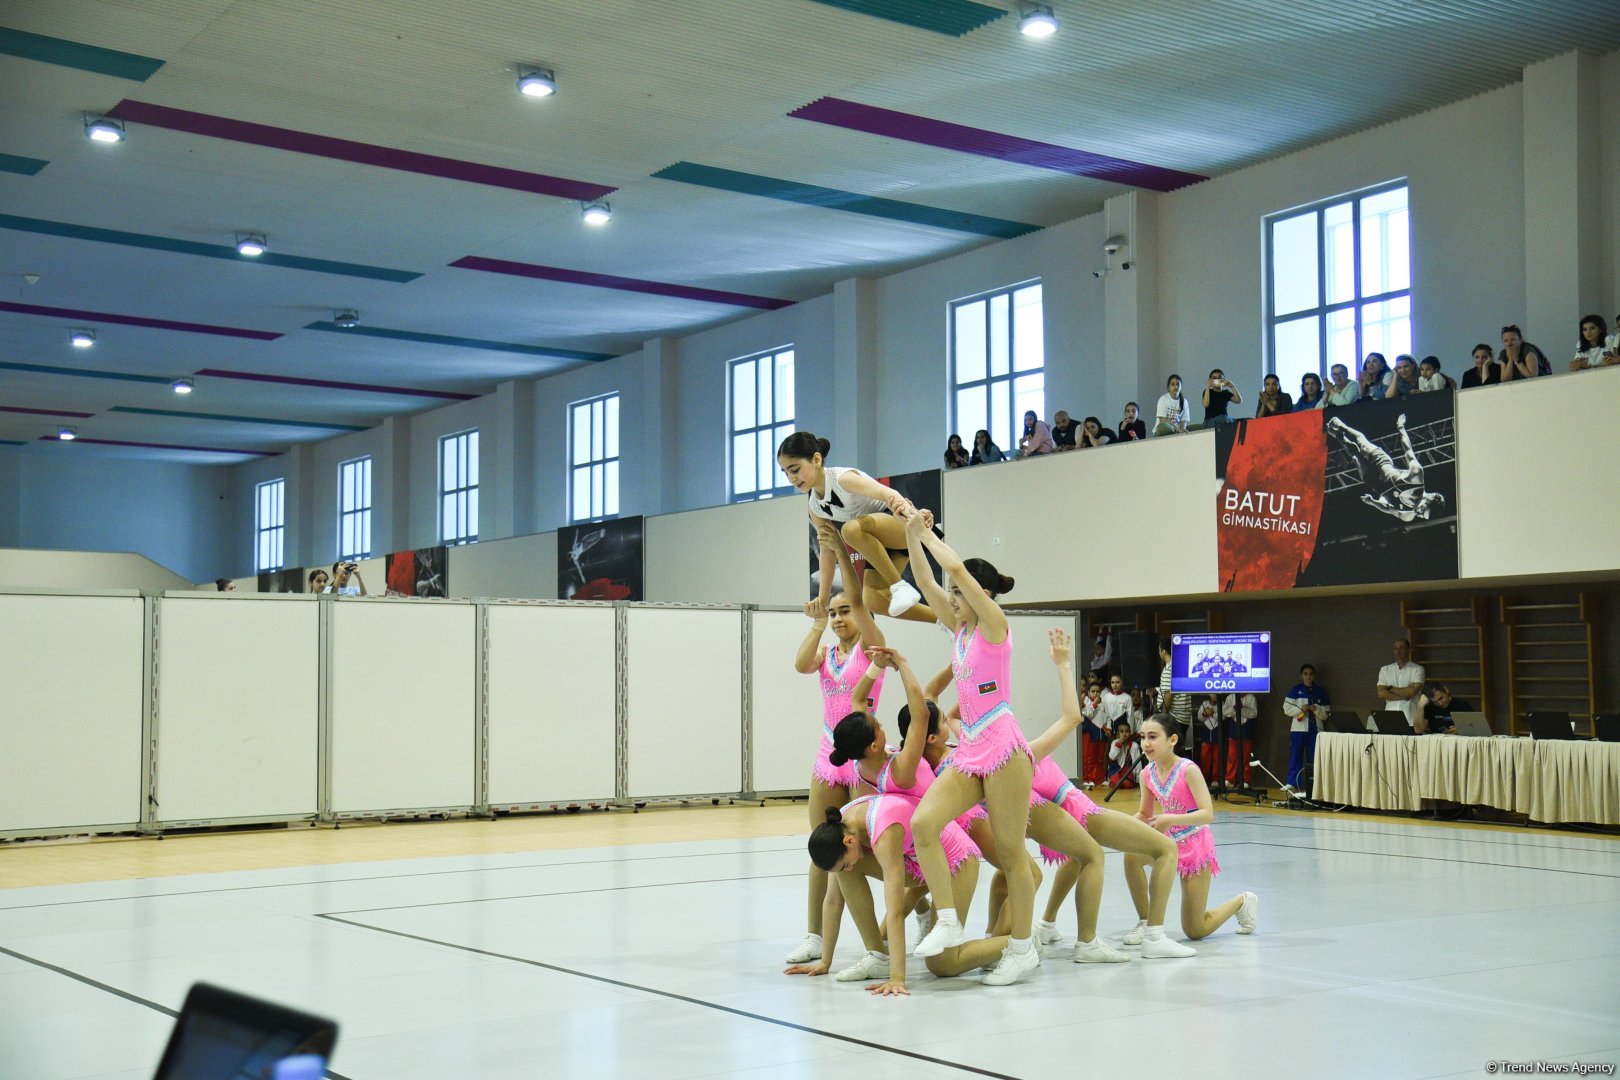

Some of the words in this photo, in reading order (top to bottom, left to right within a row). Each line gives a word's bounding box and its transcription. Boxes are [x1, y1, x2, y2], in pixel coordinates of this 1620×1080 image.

[1225, 489, 1300, 516] BATUT
[1223, 512, 1311, 535] GİMNASTİKASI
[1205, 680, 1236, 689] OCAQ
